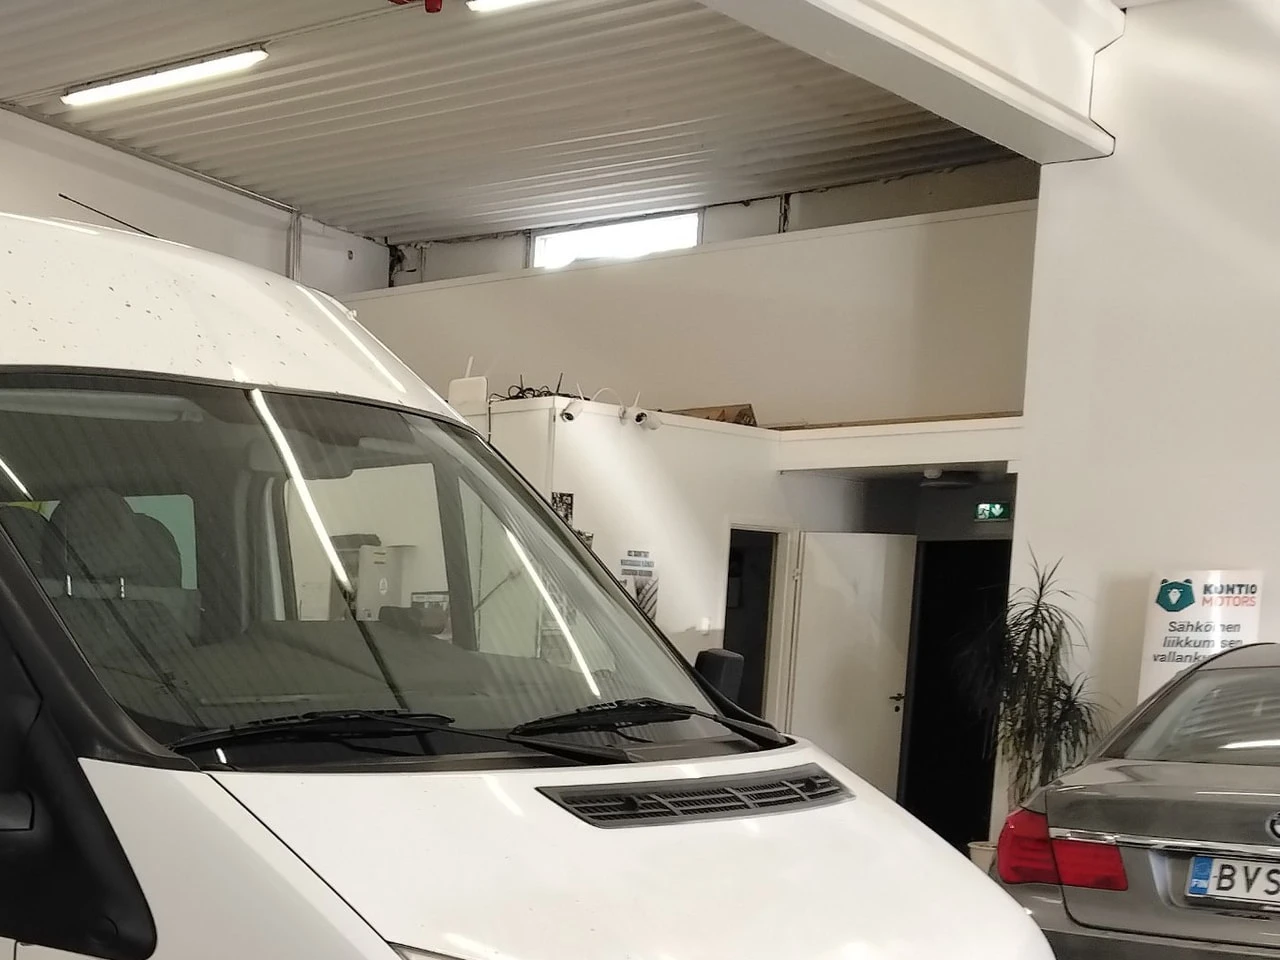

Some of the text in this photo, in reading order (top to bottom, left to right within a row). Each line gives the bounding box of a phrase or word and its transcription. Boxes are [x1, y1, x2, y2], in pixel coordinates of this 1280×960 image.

[1201, 595, 1257, 607] MOTORS
[1168, 620, 1241, 633] Sähkönen
[1162, 635, 1243, 648] liikkumsen
